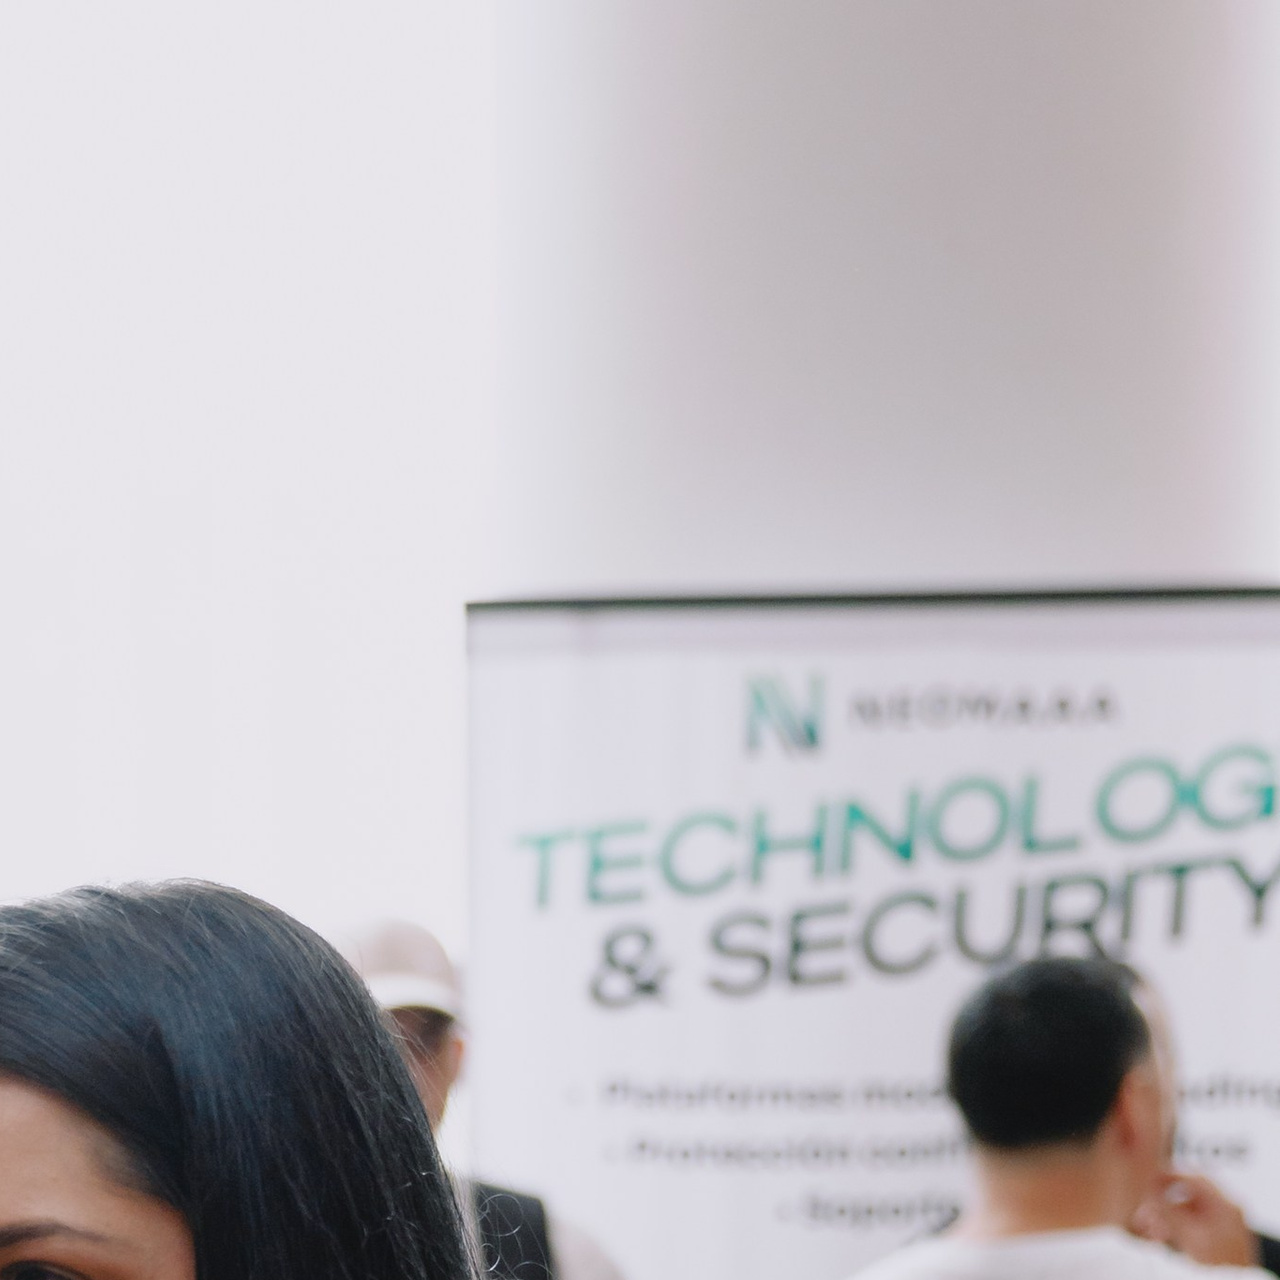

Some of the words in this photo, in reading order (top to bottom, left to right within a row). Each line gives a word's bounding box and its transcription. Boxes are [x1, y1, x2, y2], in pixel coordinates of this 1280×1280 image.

[847, 685, 1122, 730] NEOMAAA
[584, 921, 672, 1010] &
[702, 852, 1280, 998] SECURITY
